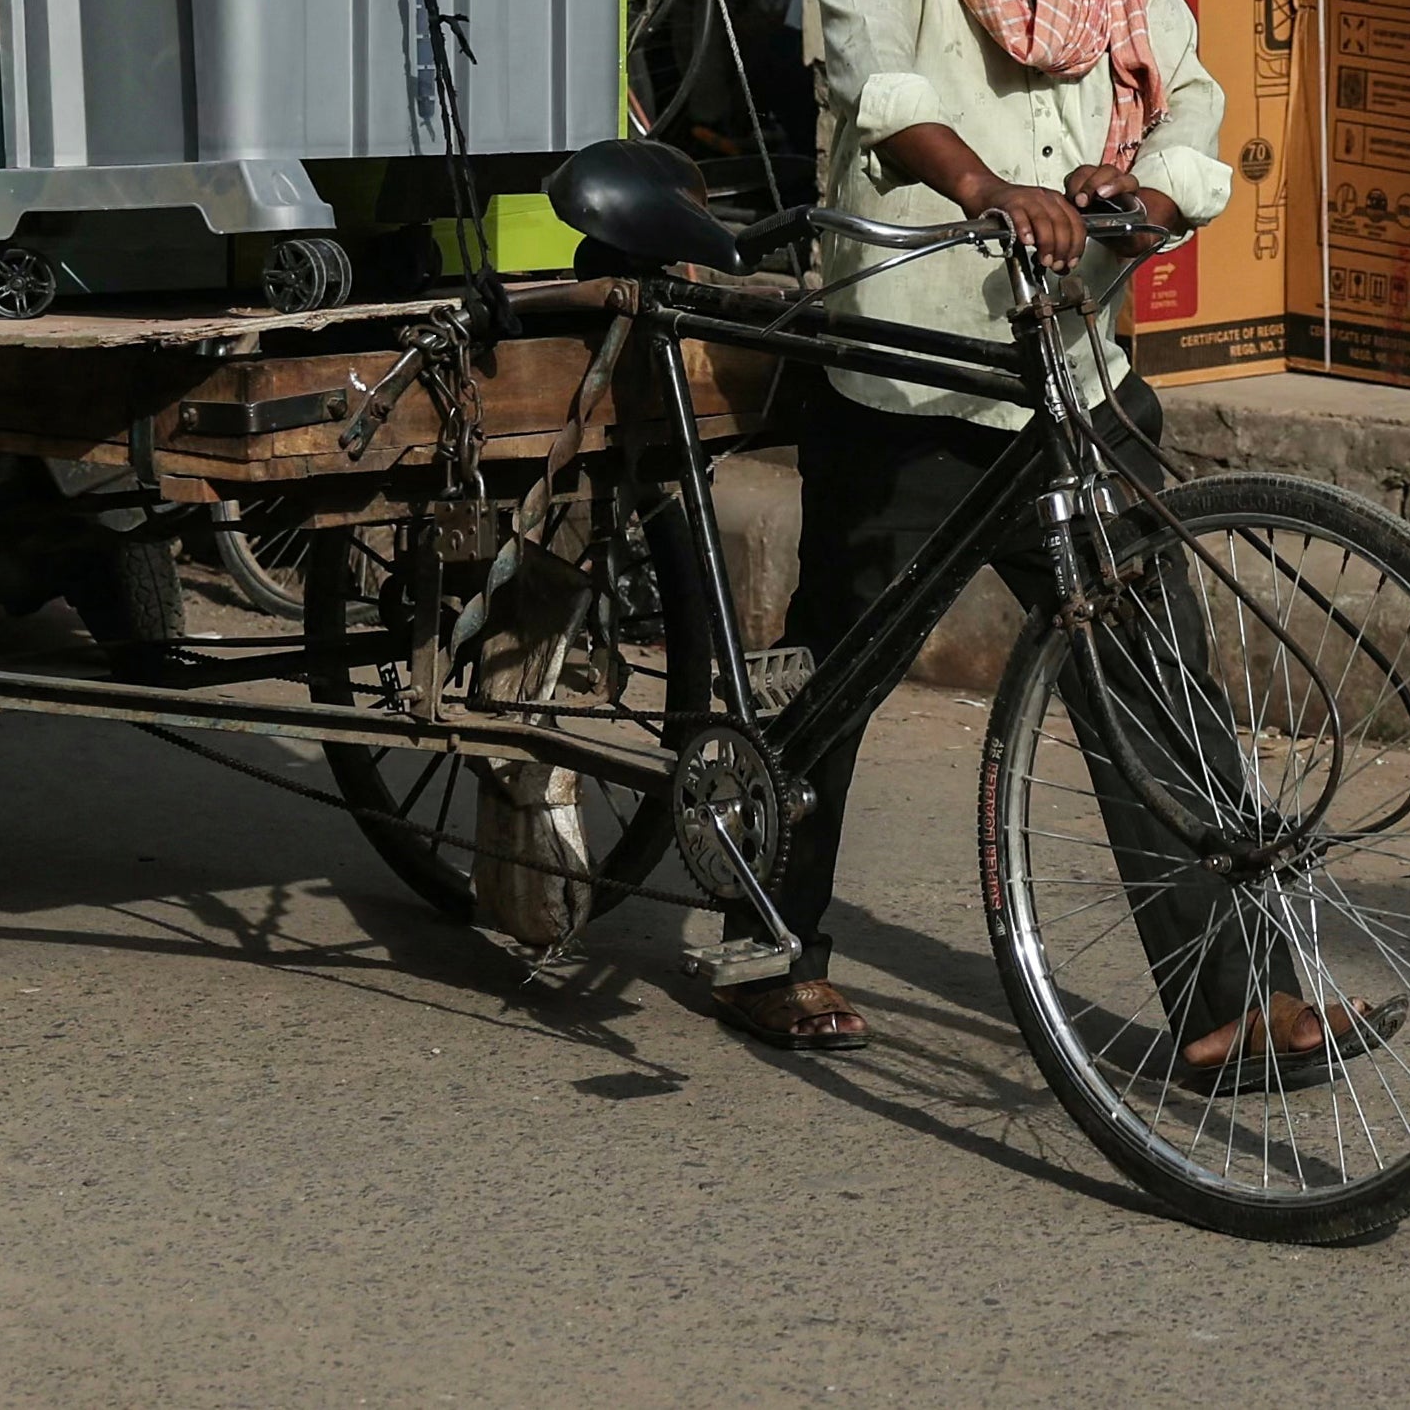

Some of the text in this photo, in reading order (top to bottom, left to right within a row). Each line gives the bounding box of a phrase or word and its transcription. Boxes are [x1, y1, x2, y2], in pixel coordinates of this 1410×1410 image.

[1248, 144, 1266, 160] 70
[1180, 323, 1285, 348] CERTIFICATE OF REGIS
[1229, 340, 1277, 358] REGD. NO.
[983, 761, 999, 840] LOADER
[985, 846, 1002, 910] SUPER
